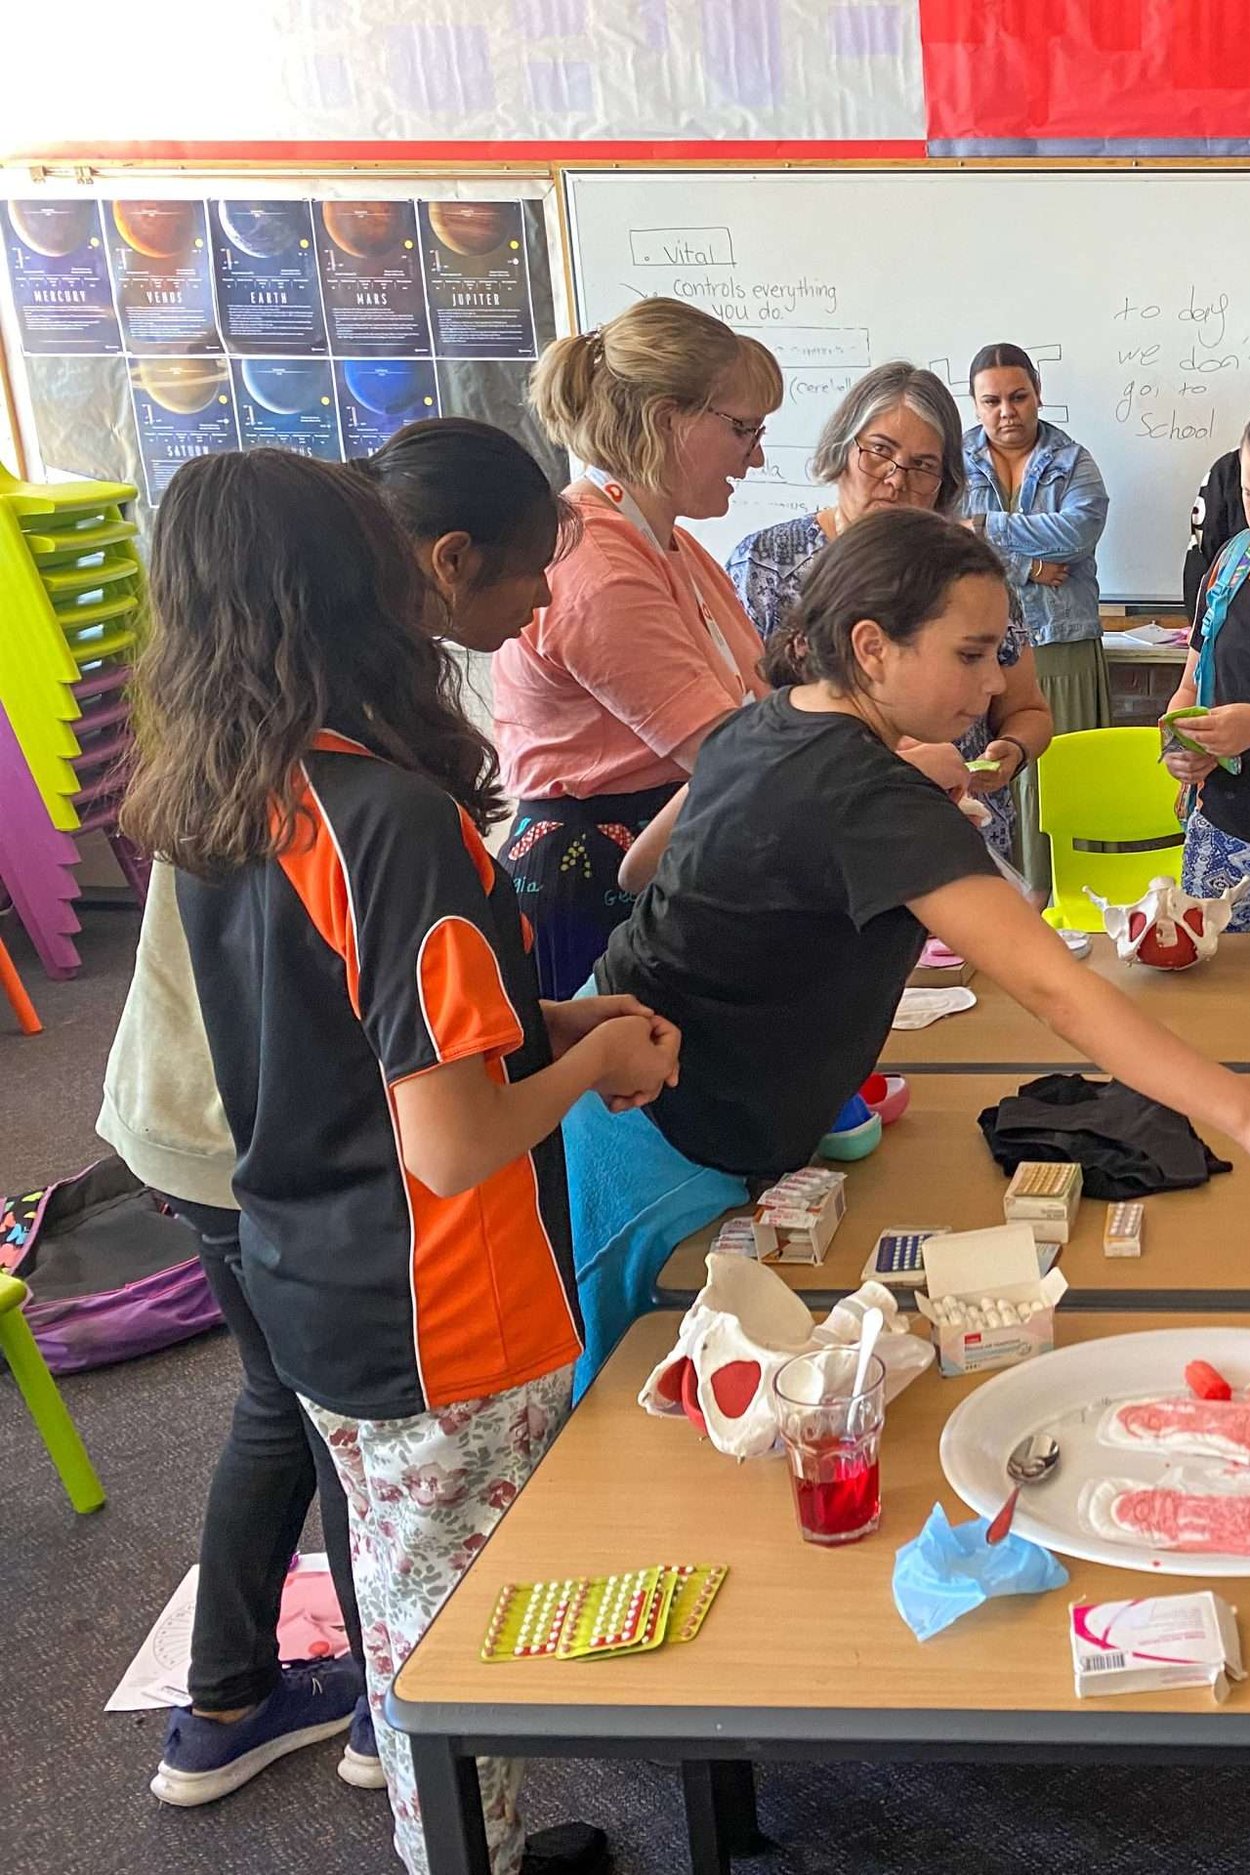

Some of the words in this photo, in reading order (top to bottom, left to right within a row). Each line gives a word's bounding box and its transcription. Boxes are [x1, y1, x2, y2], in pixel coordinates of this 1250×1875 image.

[33, 290, 86, 303] MERCURY
[147, 291, 183, 304] VENUS
[250, 292, 288, 304] EARTH
[356, 293, 388, 305] MARS
[452, 293, 500, 307] JUPITER
[752, 277, 837, 314] everything
[712, 303, 749, 321] you
[167, 445, 209, 457] SATURN
